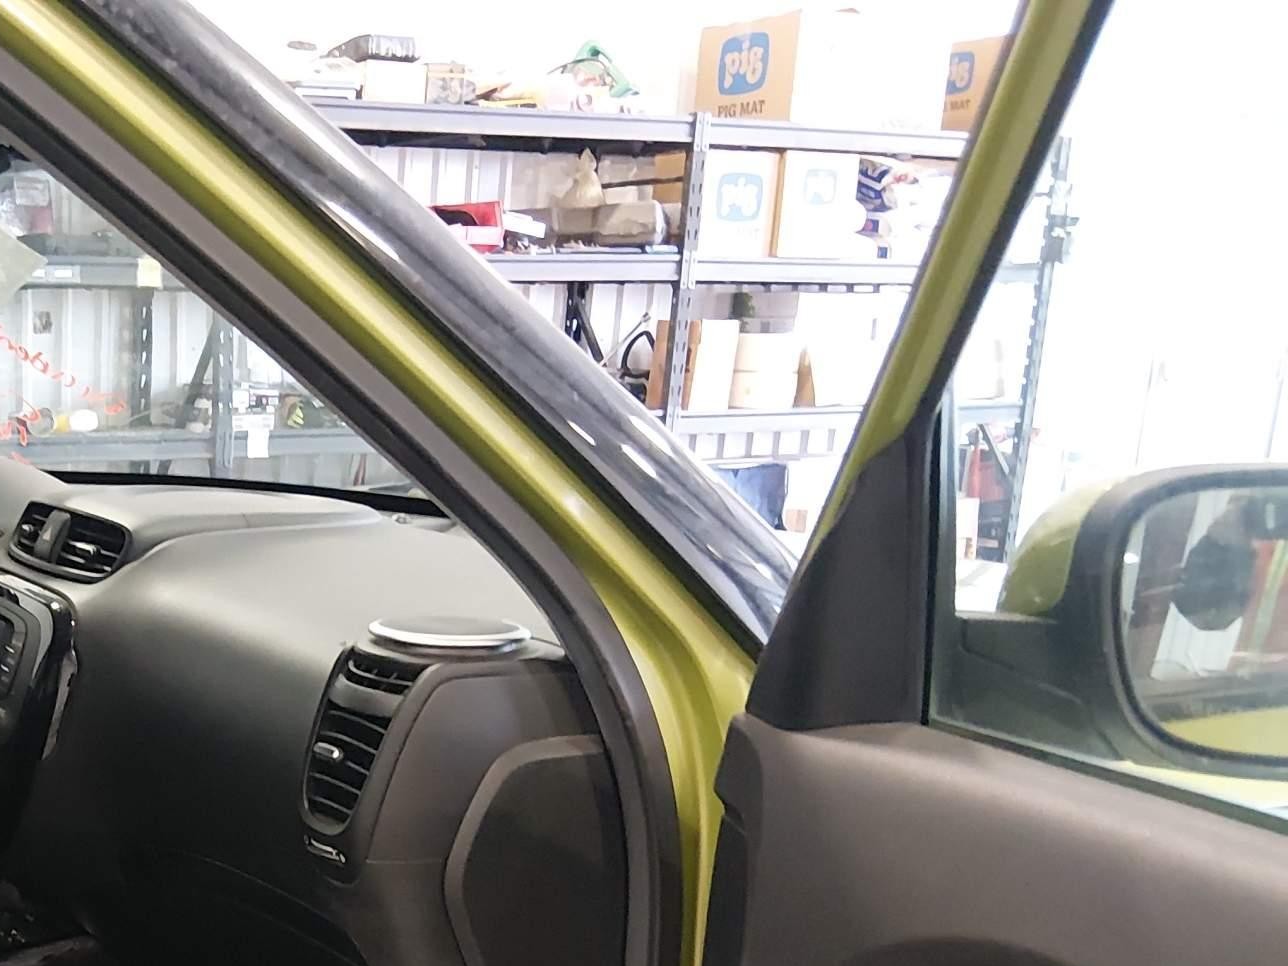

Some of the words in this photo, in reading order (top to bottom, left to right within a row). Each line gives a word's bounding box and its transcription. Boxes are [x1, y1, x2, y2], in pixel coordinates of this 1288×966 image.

[723, 41, 764, 89] pig
[950, 56, 971, 89] ig
[717, 103, 737, 119] PIG
[740, 100, 765, 116] MAT
